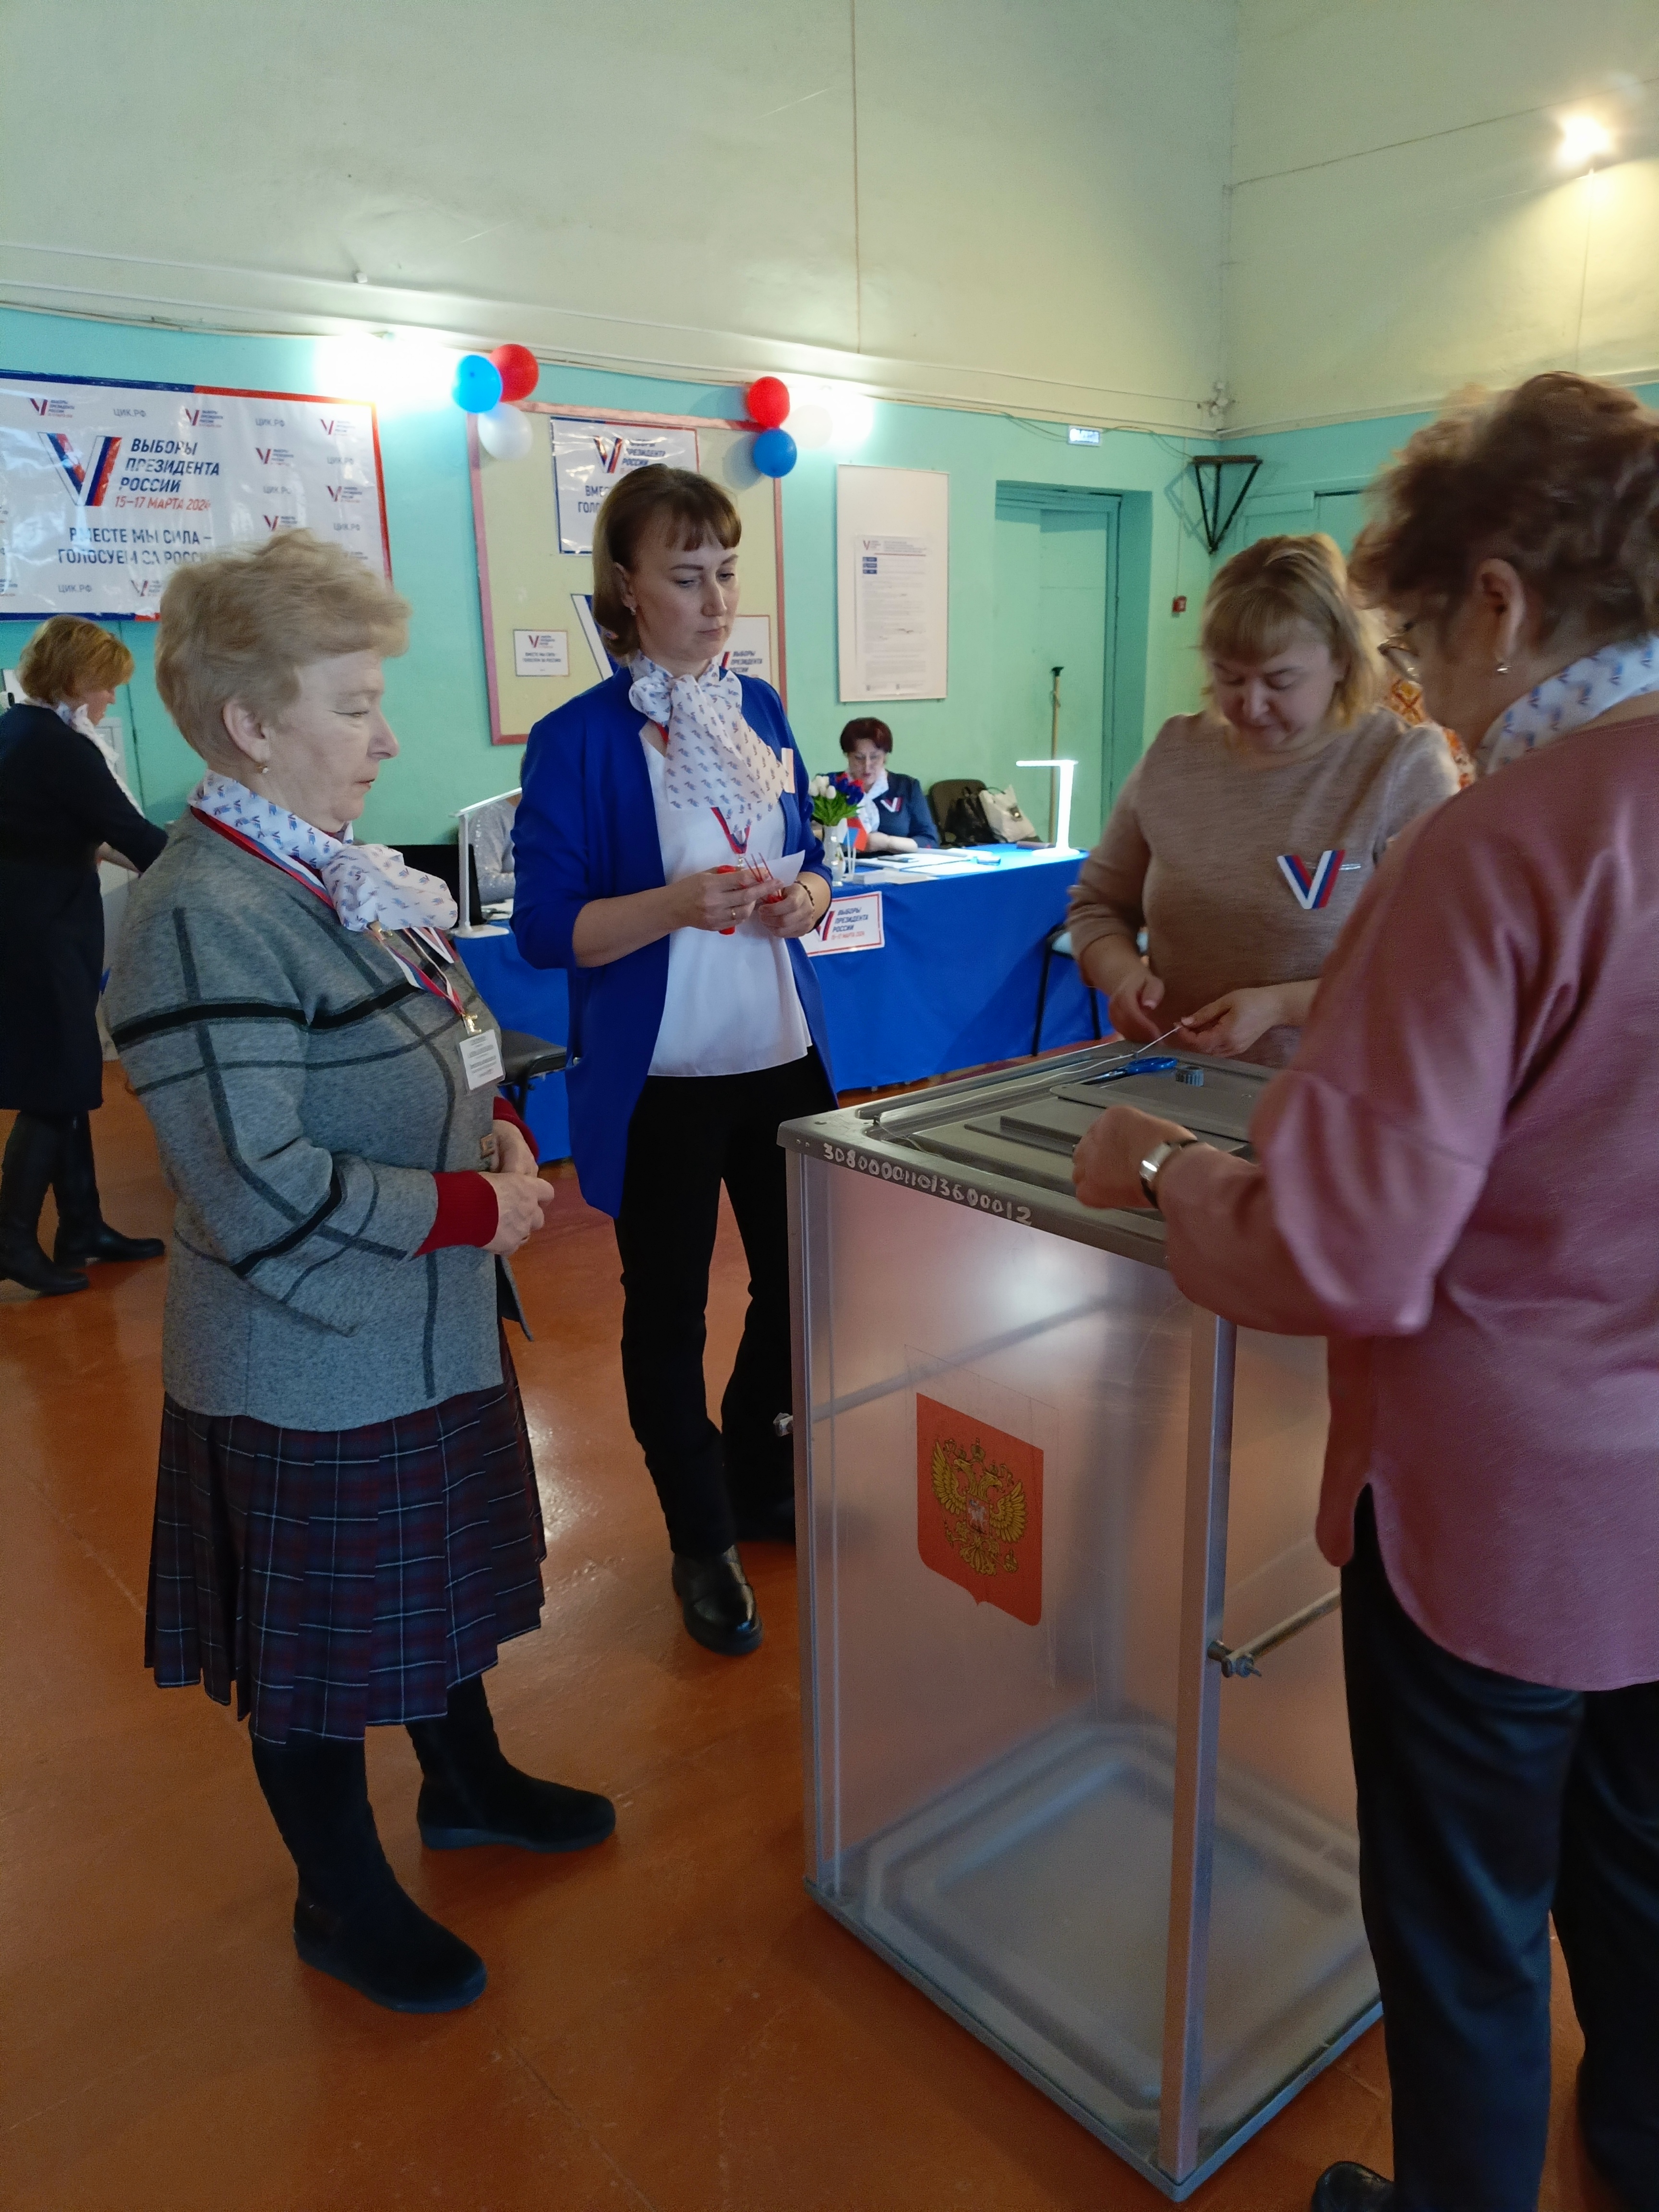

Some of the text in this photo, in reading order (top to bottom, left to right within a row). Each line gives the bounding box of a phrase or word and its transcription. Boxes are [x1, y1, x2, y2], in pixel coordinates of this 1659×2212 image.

[131, 438, 198, 456] ВЫБОРЫ
[125, 457, 220, 476] ПРЕЗИДЕНТА
[119, 477, 181, 493] РОССИИ
[147, 497, 184, 510] МАРТА
[132, 529, 159, 543] МЫ
[163, 529, 200, 545] СИЛА
